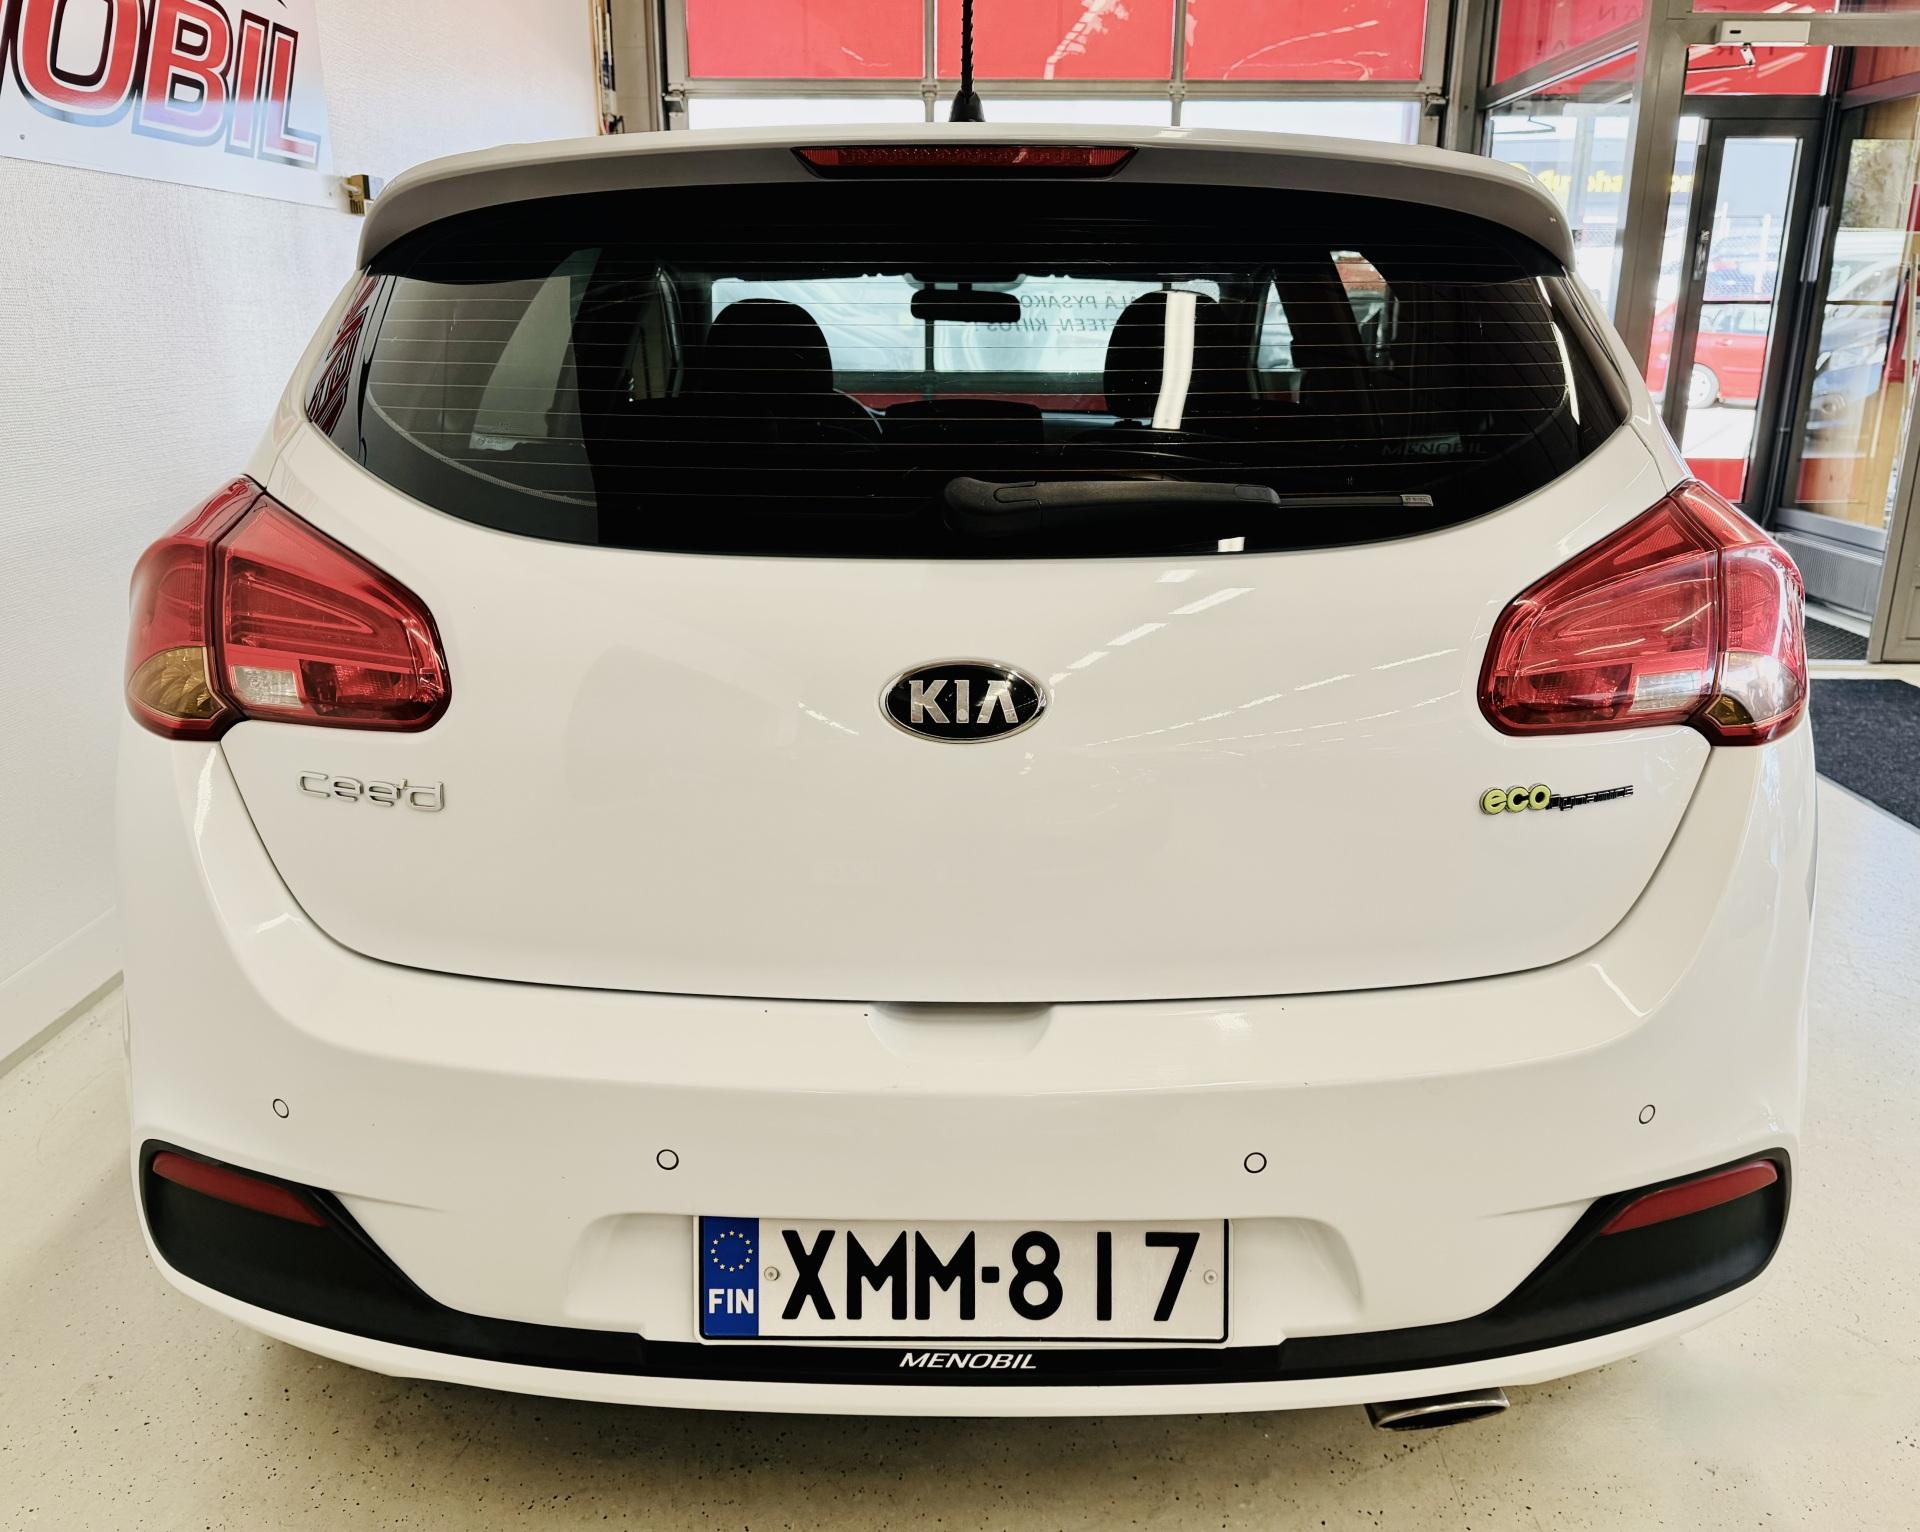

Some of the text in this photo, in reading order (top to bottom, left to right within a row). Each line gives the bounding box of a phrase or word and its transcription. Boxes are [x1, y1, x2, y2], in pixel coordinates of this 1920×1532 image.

[0, 0, 322, 170] OBIL
[909, 679, 1019, 723] KIA
[781, 1229, 1201, 1322] XMM-817
[708, 1287, 754, 1315] FIN
[899, 1352, 1037, 1369] MENOBIL
